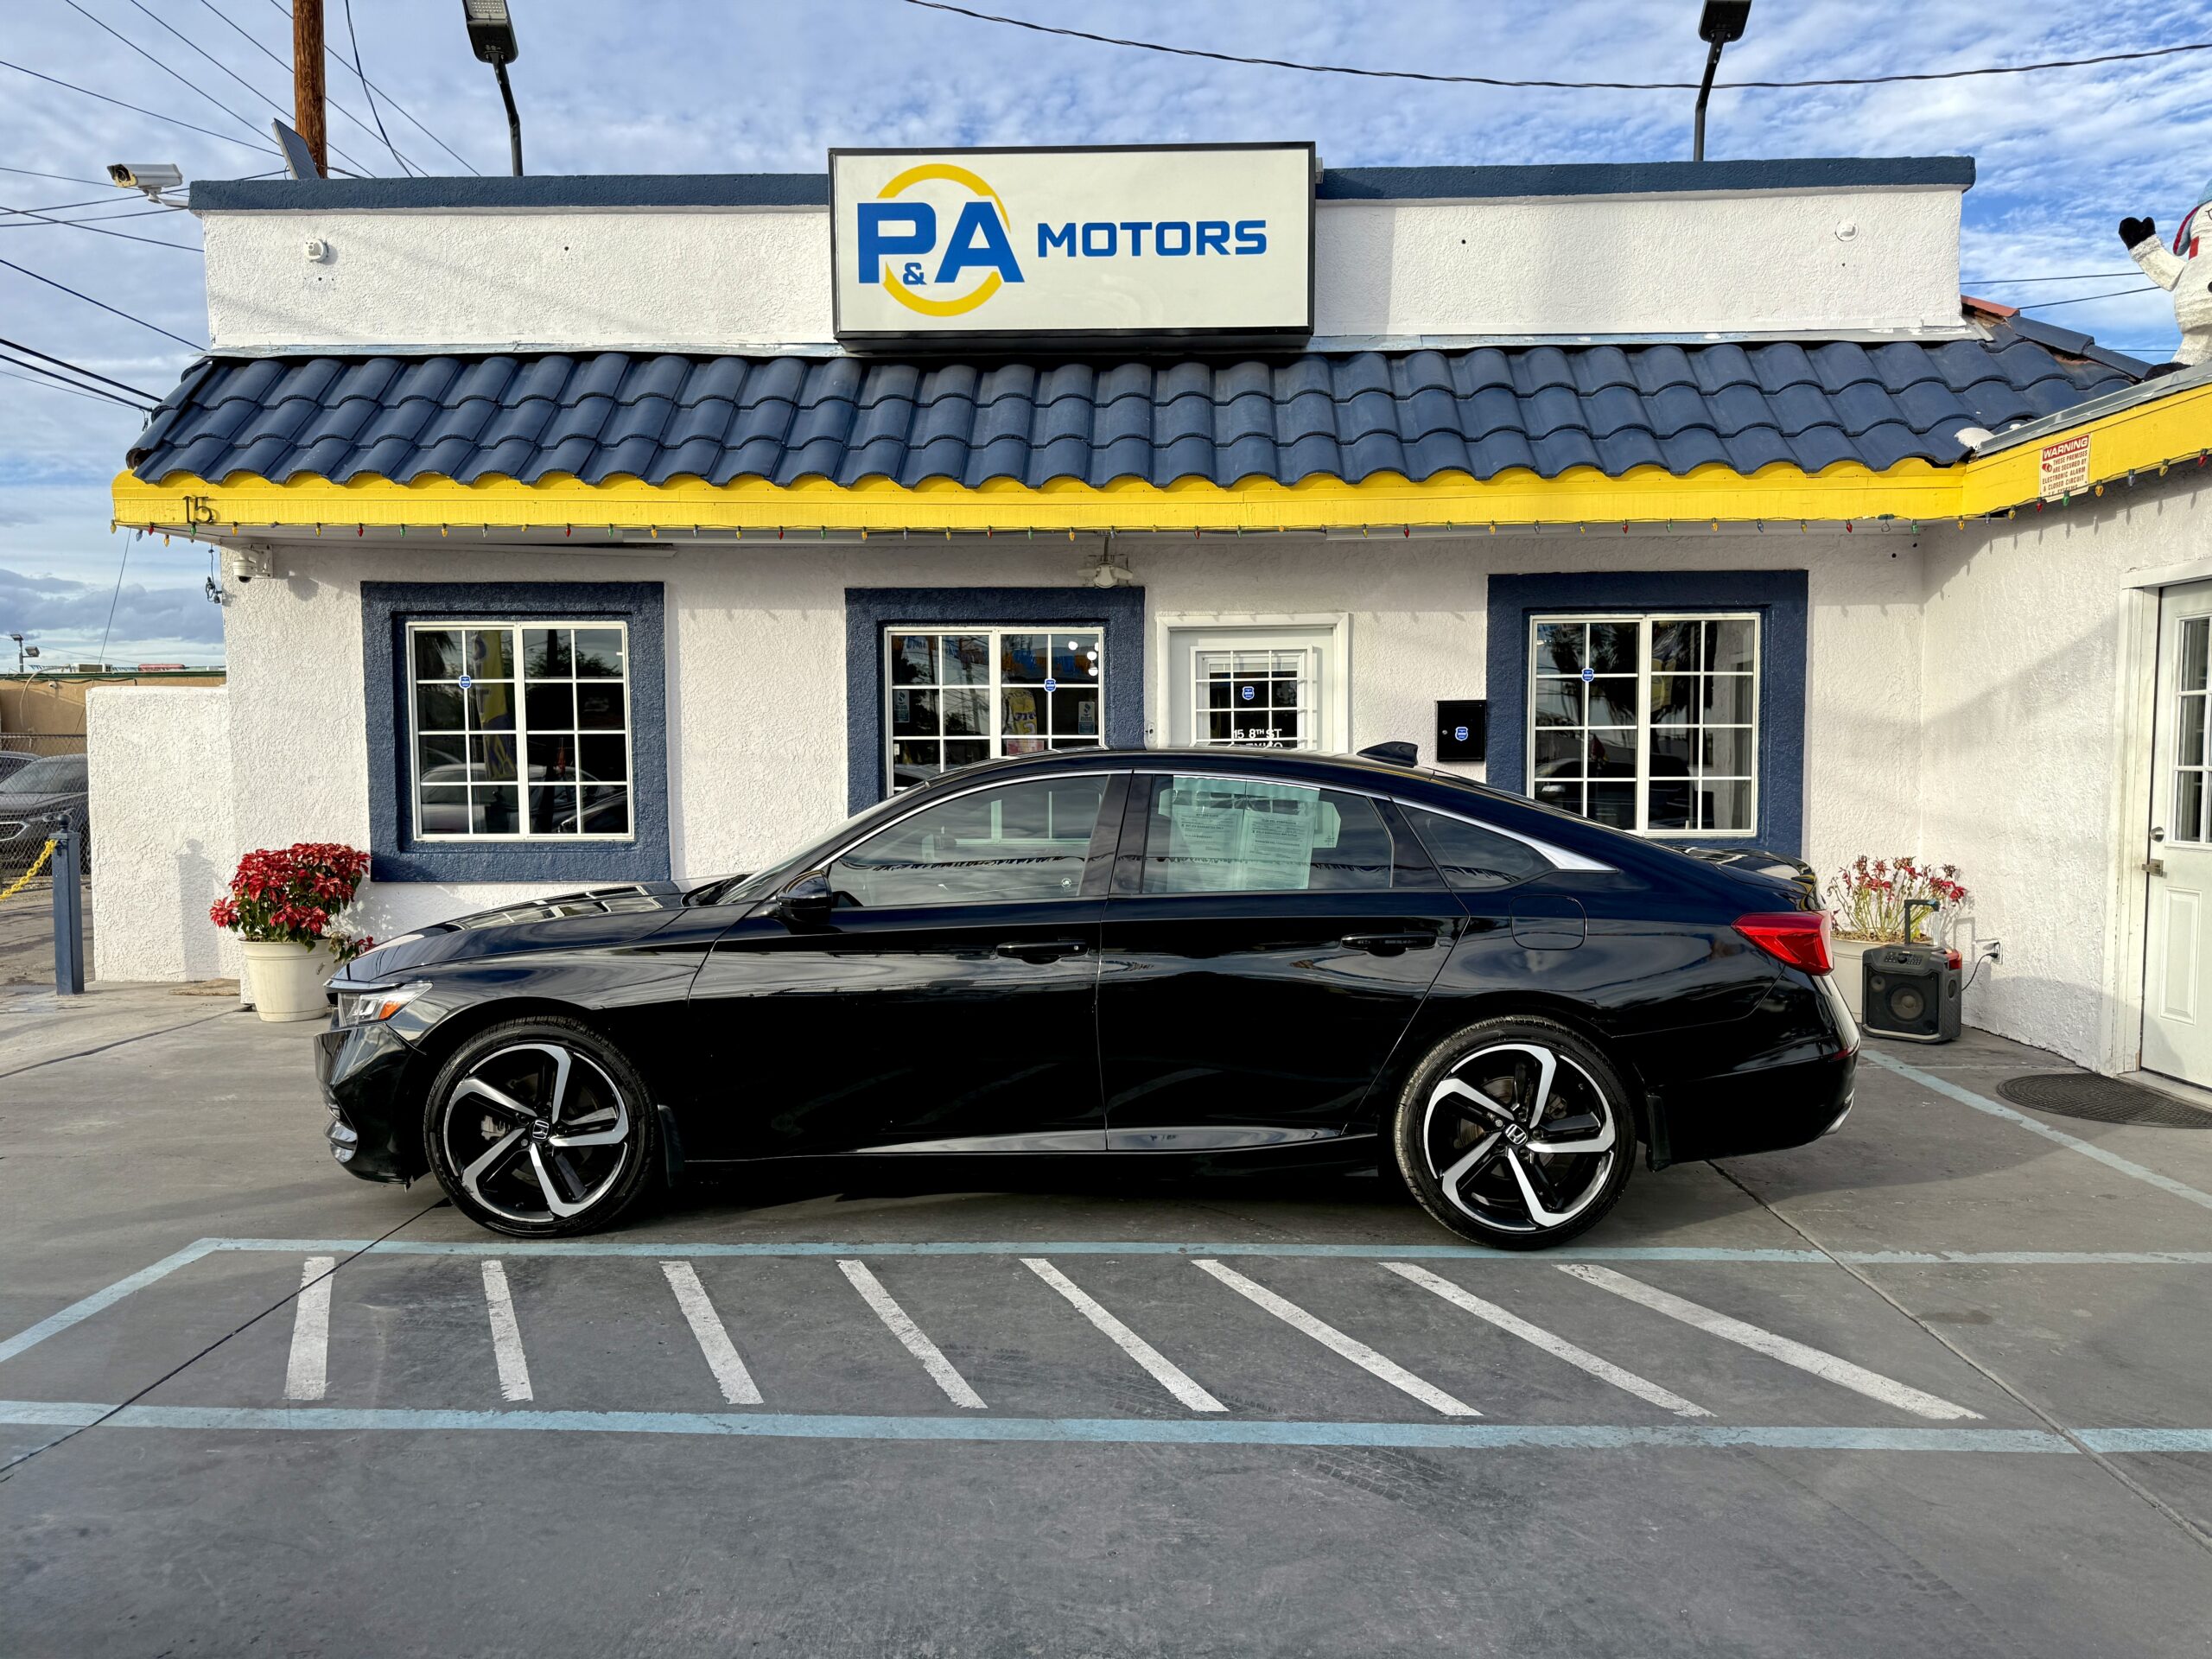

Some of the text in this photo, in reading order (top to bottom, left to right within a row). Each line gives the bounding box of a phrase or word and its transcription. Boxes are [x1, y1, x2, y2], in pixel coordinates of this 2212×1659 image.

[1038, 219, 1267, 257] MOTORS
[2044, 437, 2088, 460] WARNING
[2053, 450, 2088, 467] THESE PREMISES
[2061, 460, 2081, 471] SECURED
[2042, 467, 2086, 485] ELECTRONIC ALARM
[2048, 480, 2064, 491] CLOSED
[2065, 474, 2084, 485] CIRCUIT
[182, 496, 212, 524] 15
[1234, 728, 1245, 739] 15
[1266, 728, 1283, 739] ST
